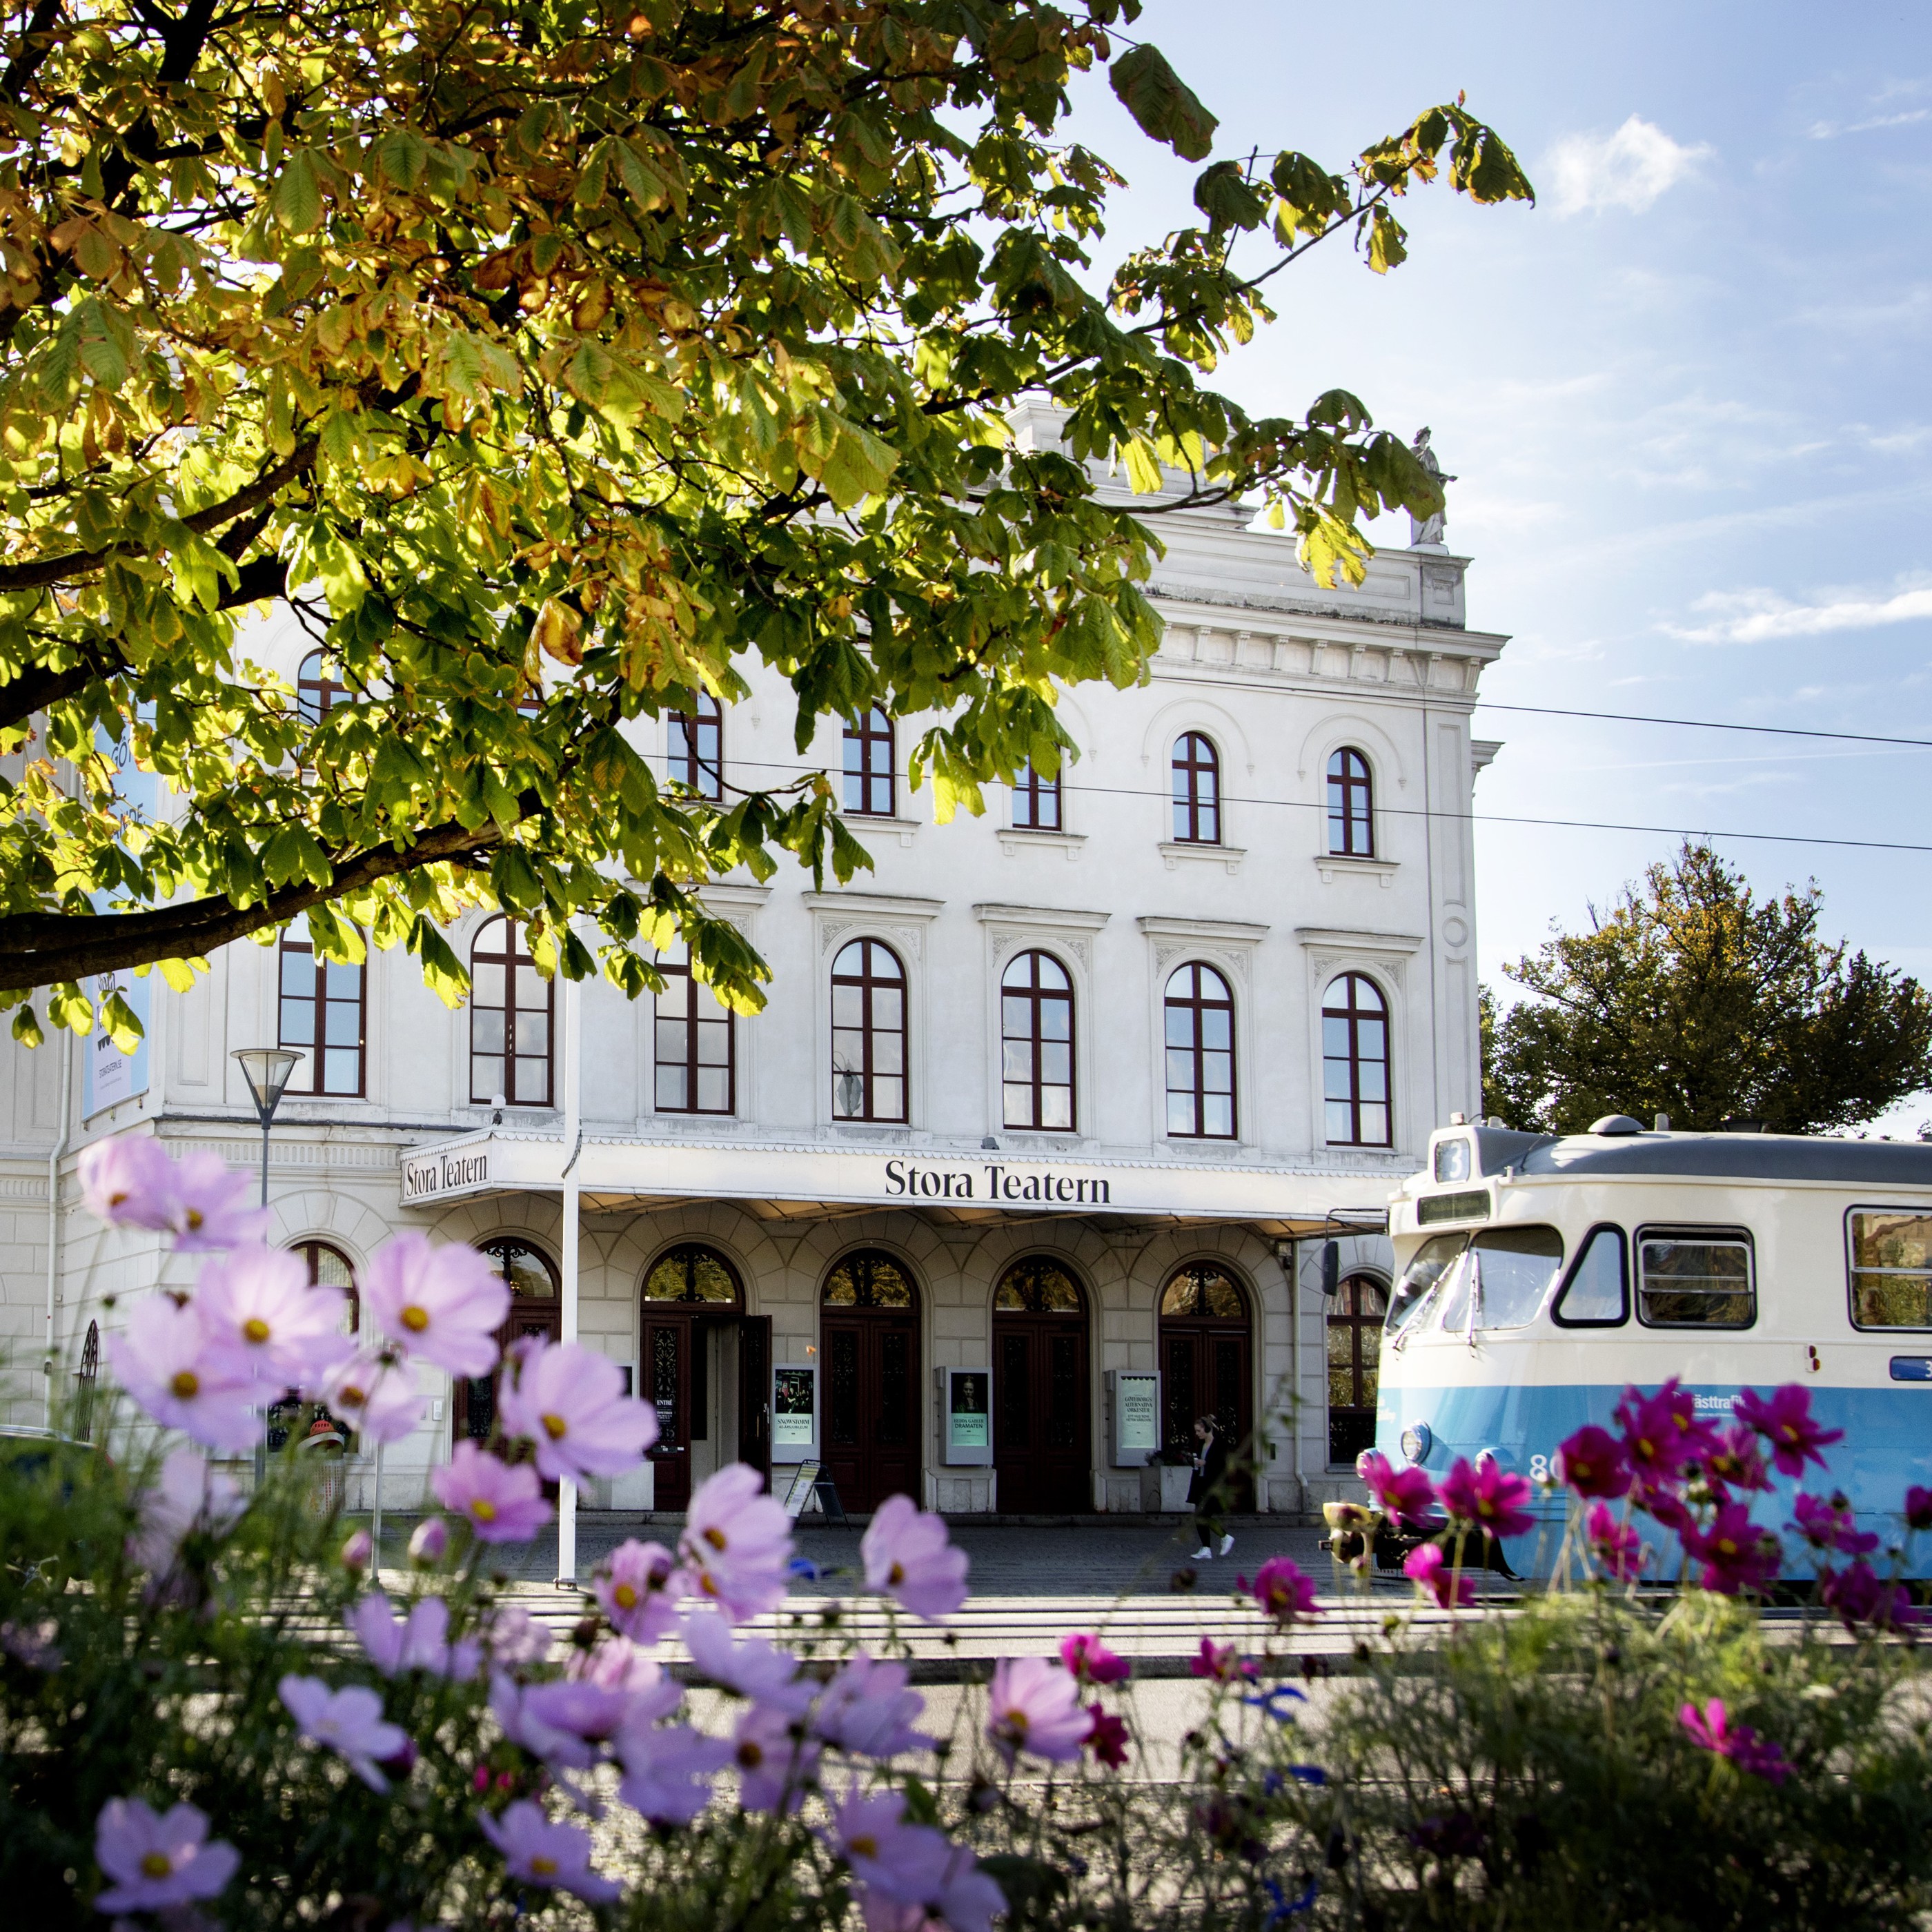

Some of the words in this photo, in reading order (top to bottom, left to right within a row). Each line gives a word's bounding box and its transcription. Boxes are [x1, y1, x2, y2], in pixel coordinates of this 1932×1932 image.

[406, 1163, 436, 1196] Stora
[440, 1155, 487, 1189] Teatern
[1449, 1141, 1463, 1179] 3
[885, 1160, 974, 1198] Stora
[985, 1165, 1111, 1203] Teatern
